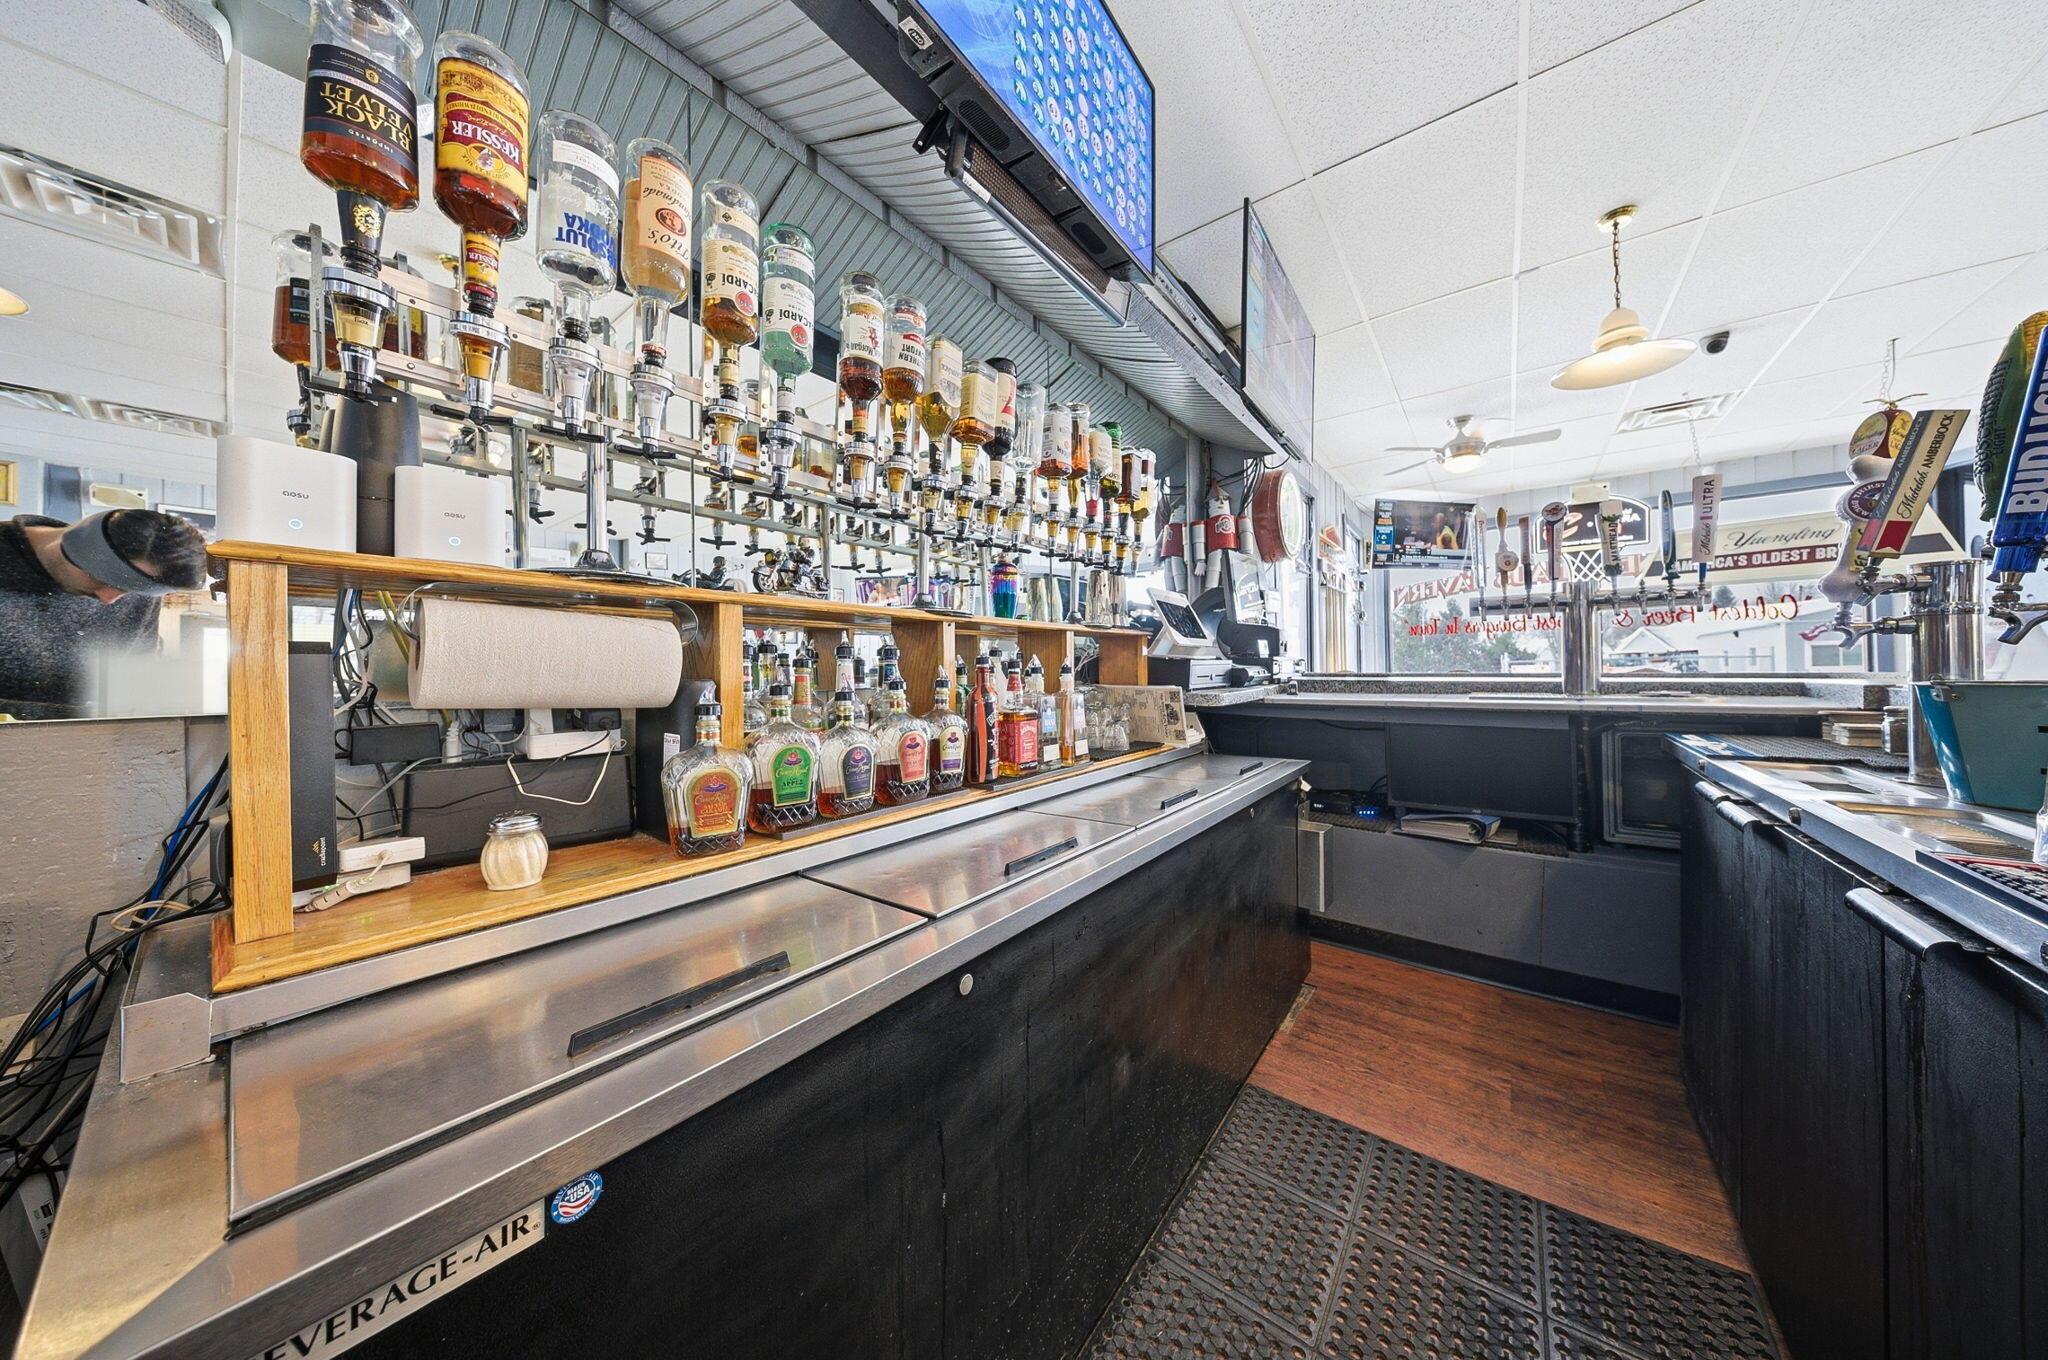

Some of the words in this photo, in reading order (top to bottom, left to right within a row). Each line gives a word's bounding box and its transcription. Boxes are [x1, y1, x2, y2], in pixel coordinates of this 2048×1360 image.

[319, 81, 414, 140] VELVET
[323, 97, 411, 154] BLACK
[344, 128, 394, 153] IMPORTED
[450, 120, 520, 163] KESSLER
[642, 187, 692, 221] Handmade
[563, 212, 617, 250] VODKA
[647, 228, 689, 261] Tito's
[468, 251, 498, 269] KESSLER
[555, 227, 617, 271] ABSOLUT
[850, 342, 874, 357] Morgan
[1897, 469, 1928, 520] Michelob
[1922, 412, 1955, 469] AMBERBOCK
[282, 490, 310, 500] aosu
[1703, 479, 1715, 515] ULTRA
[444, 512, 466, 520] aosu
[1724, 524, 1841, 551] Yuengling
[1751, 546, 1822, 565] OLDEST
[569, 1184, 591, 1203] USA
